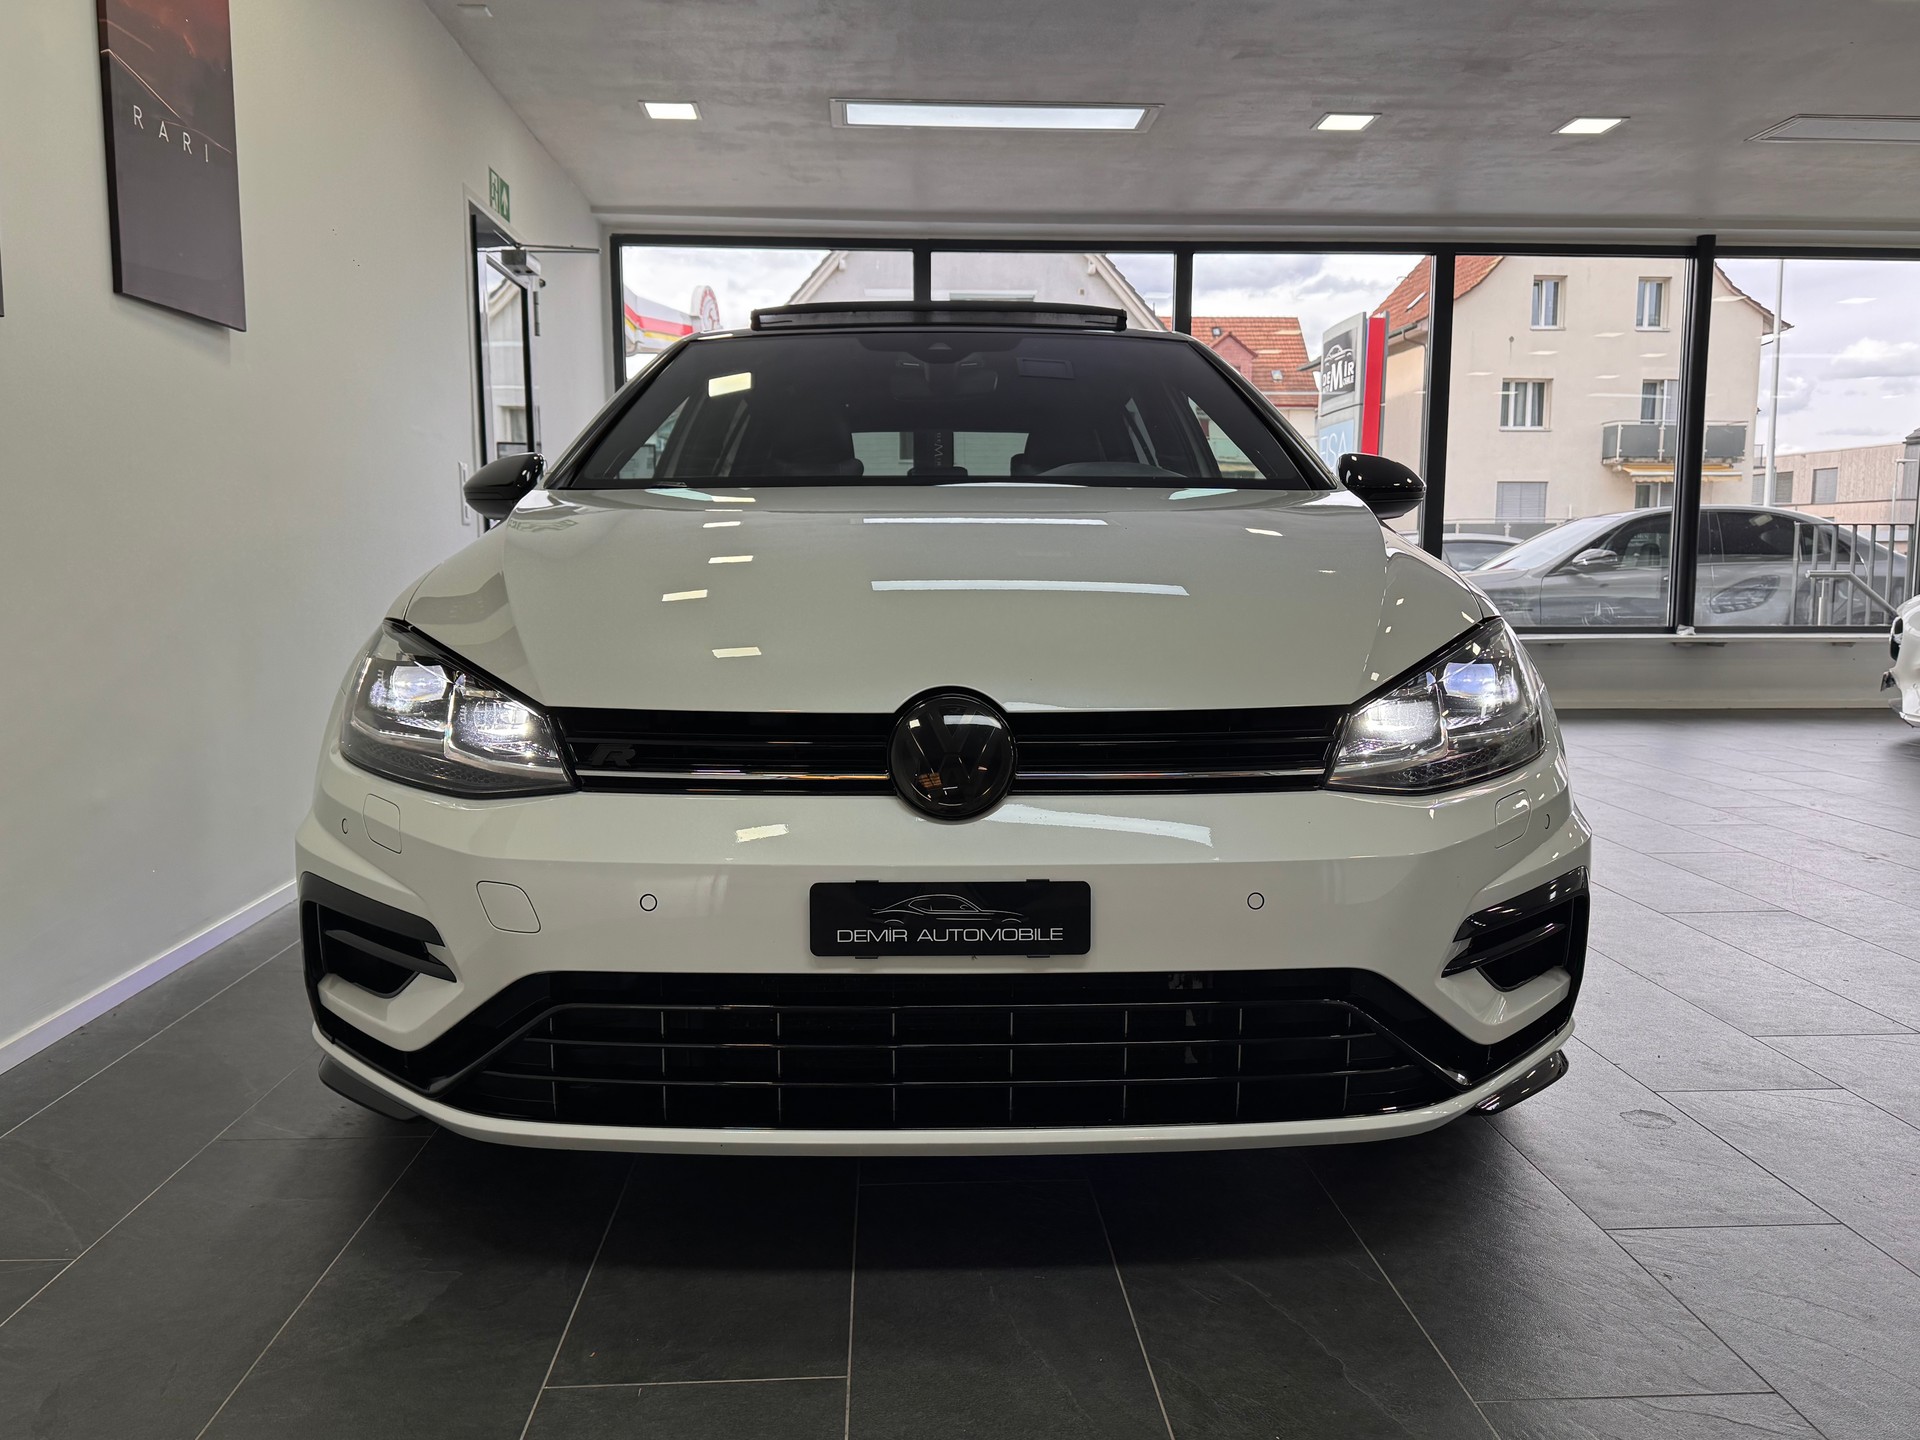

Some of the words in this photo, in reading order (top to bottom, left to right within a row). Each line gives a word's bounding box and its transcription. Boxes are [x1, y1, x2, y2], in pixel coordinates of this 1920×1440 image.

[132, 104, 209, 163] RARI
[588, 743, 636, 767] R
[916, 927, 1064, 942] AUTOMOBILE
